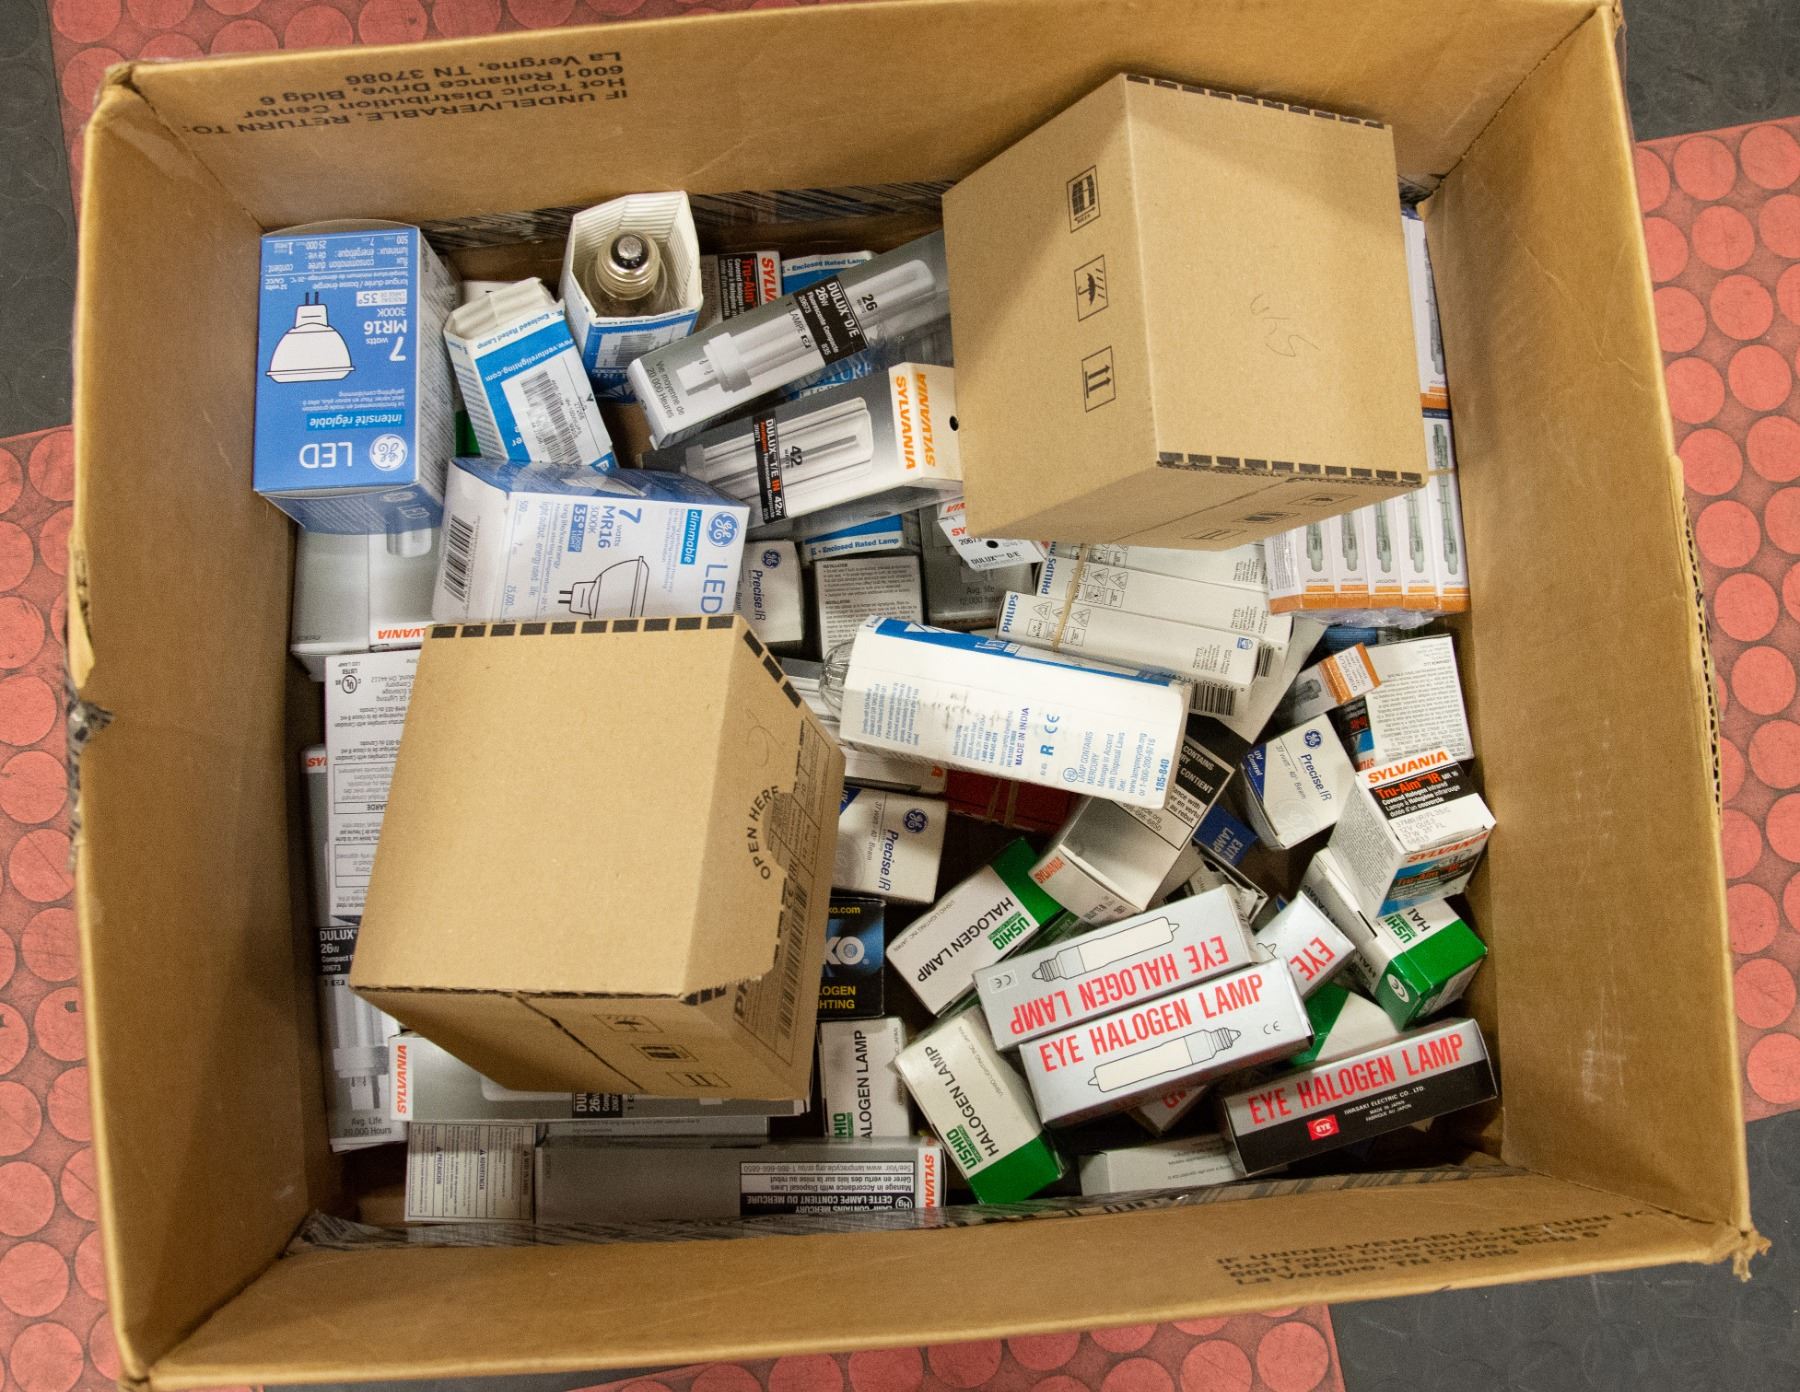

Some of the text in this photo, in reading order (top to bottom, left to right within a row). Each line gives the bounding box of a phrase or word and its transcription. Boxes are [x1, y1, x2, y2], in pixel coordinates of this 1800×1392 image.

[258, 63, 622, 106] 6001 Reliance Drive, Bldg 6
[344, 50, 620, 86] La Vergne, TN 37086
[242, 76, 624, 121] Hot Topic Distribution Center
[599, 89, 626, 101] IF
[235, 112, 348, 133] RETURN
[376, 307, 406, 316] 3000K
[860, 292, 878, 312] 26
[363, 319, 406, 334] MR16
[788, 308, 805, 334] LAMPE
[843, 317, 860, 338] D/E
[365, 336, 405, 360] 7 watts
[309, 413, 401, 428] intensité réglable
[658, 392, 675, 418] Heures
[895, 375, 916, 469] SYLVANIA
[915, 370, 936, 467] SYLVANIA
[298, 441, 351, 468] LED
[787, 444, 803, 467] 42
[587, 504, 599, 534] 3000K
[597, 504, 615, 549] MR16
[613, 505, 641, 547] 7 watts
[681, 509, 699, 564] dimmable
[822, 537, 899, 553] Enclosed Rated Lamp
[699, 561, 727, 615] LED
[1041, 557, 1055, 594] PHILIPS
[752, 569, 765, 620] Precise IR
[1002, 593, 1017, 632] PHILIPS
[377, 627, 425, 639] LVANIA
[1014, 706, 1029, 765] MADE IN INDIA
[1077, 730, 1093, 783] LAMP CONTAINS
[1087, 752, 1100, 785] MERCURY
[1154, 757, 1169, 792] 185-840
[1182, 744, 1214, 771] CONTAINS
[1300, 753, 1325, 790] Precise
[1368, 750, 1448, 785] SYLVANIA
[1180, 767, 1212, 794] CONTIENT
[749, 785, 779, 821] HERE
[747, 827, 771, 879] OPEN
[1210, 826, 1234, 853] LAMP
[1222, 837, 1243, 860] EXIT
[878, 829, 898, 890] Precise IR
[914, 896, 1013, 982] HALOGEN LAMP
[990, 915, 1031, 951] USHIO
[1384, 913, 1413, 945] USHI
[321, 954, 348, 962] Compact
[1288, 935, 1335, 982] EYE
[1003, 934, 1229, 1036] EYE HALOGEN LAMP
[1038, 972, 1268, 1072] EYE HALOGEN LAMP
[854, 1030, 868, 1072] LAMP
[397, 1045, 406, 1112] SYLVANIA
[1245, 1031, 1468, 1125] EYE HALOGEN LAMP
[923, 1043, 998, 1157] HALOGEN LAMP
[1343, 1093, 1399, 1115] IWASAKI ELECTRIC
[833, 1113, 846, 1134] HIO
[945, 1127, 977, 1170] USHIO
[746, 1195, 892, 1203] CETTE LAMPE CONTIENT MERCURE
